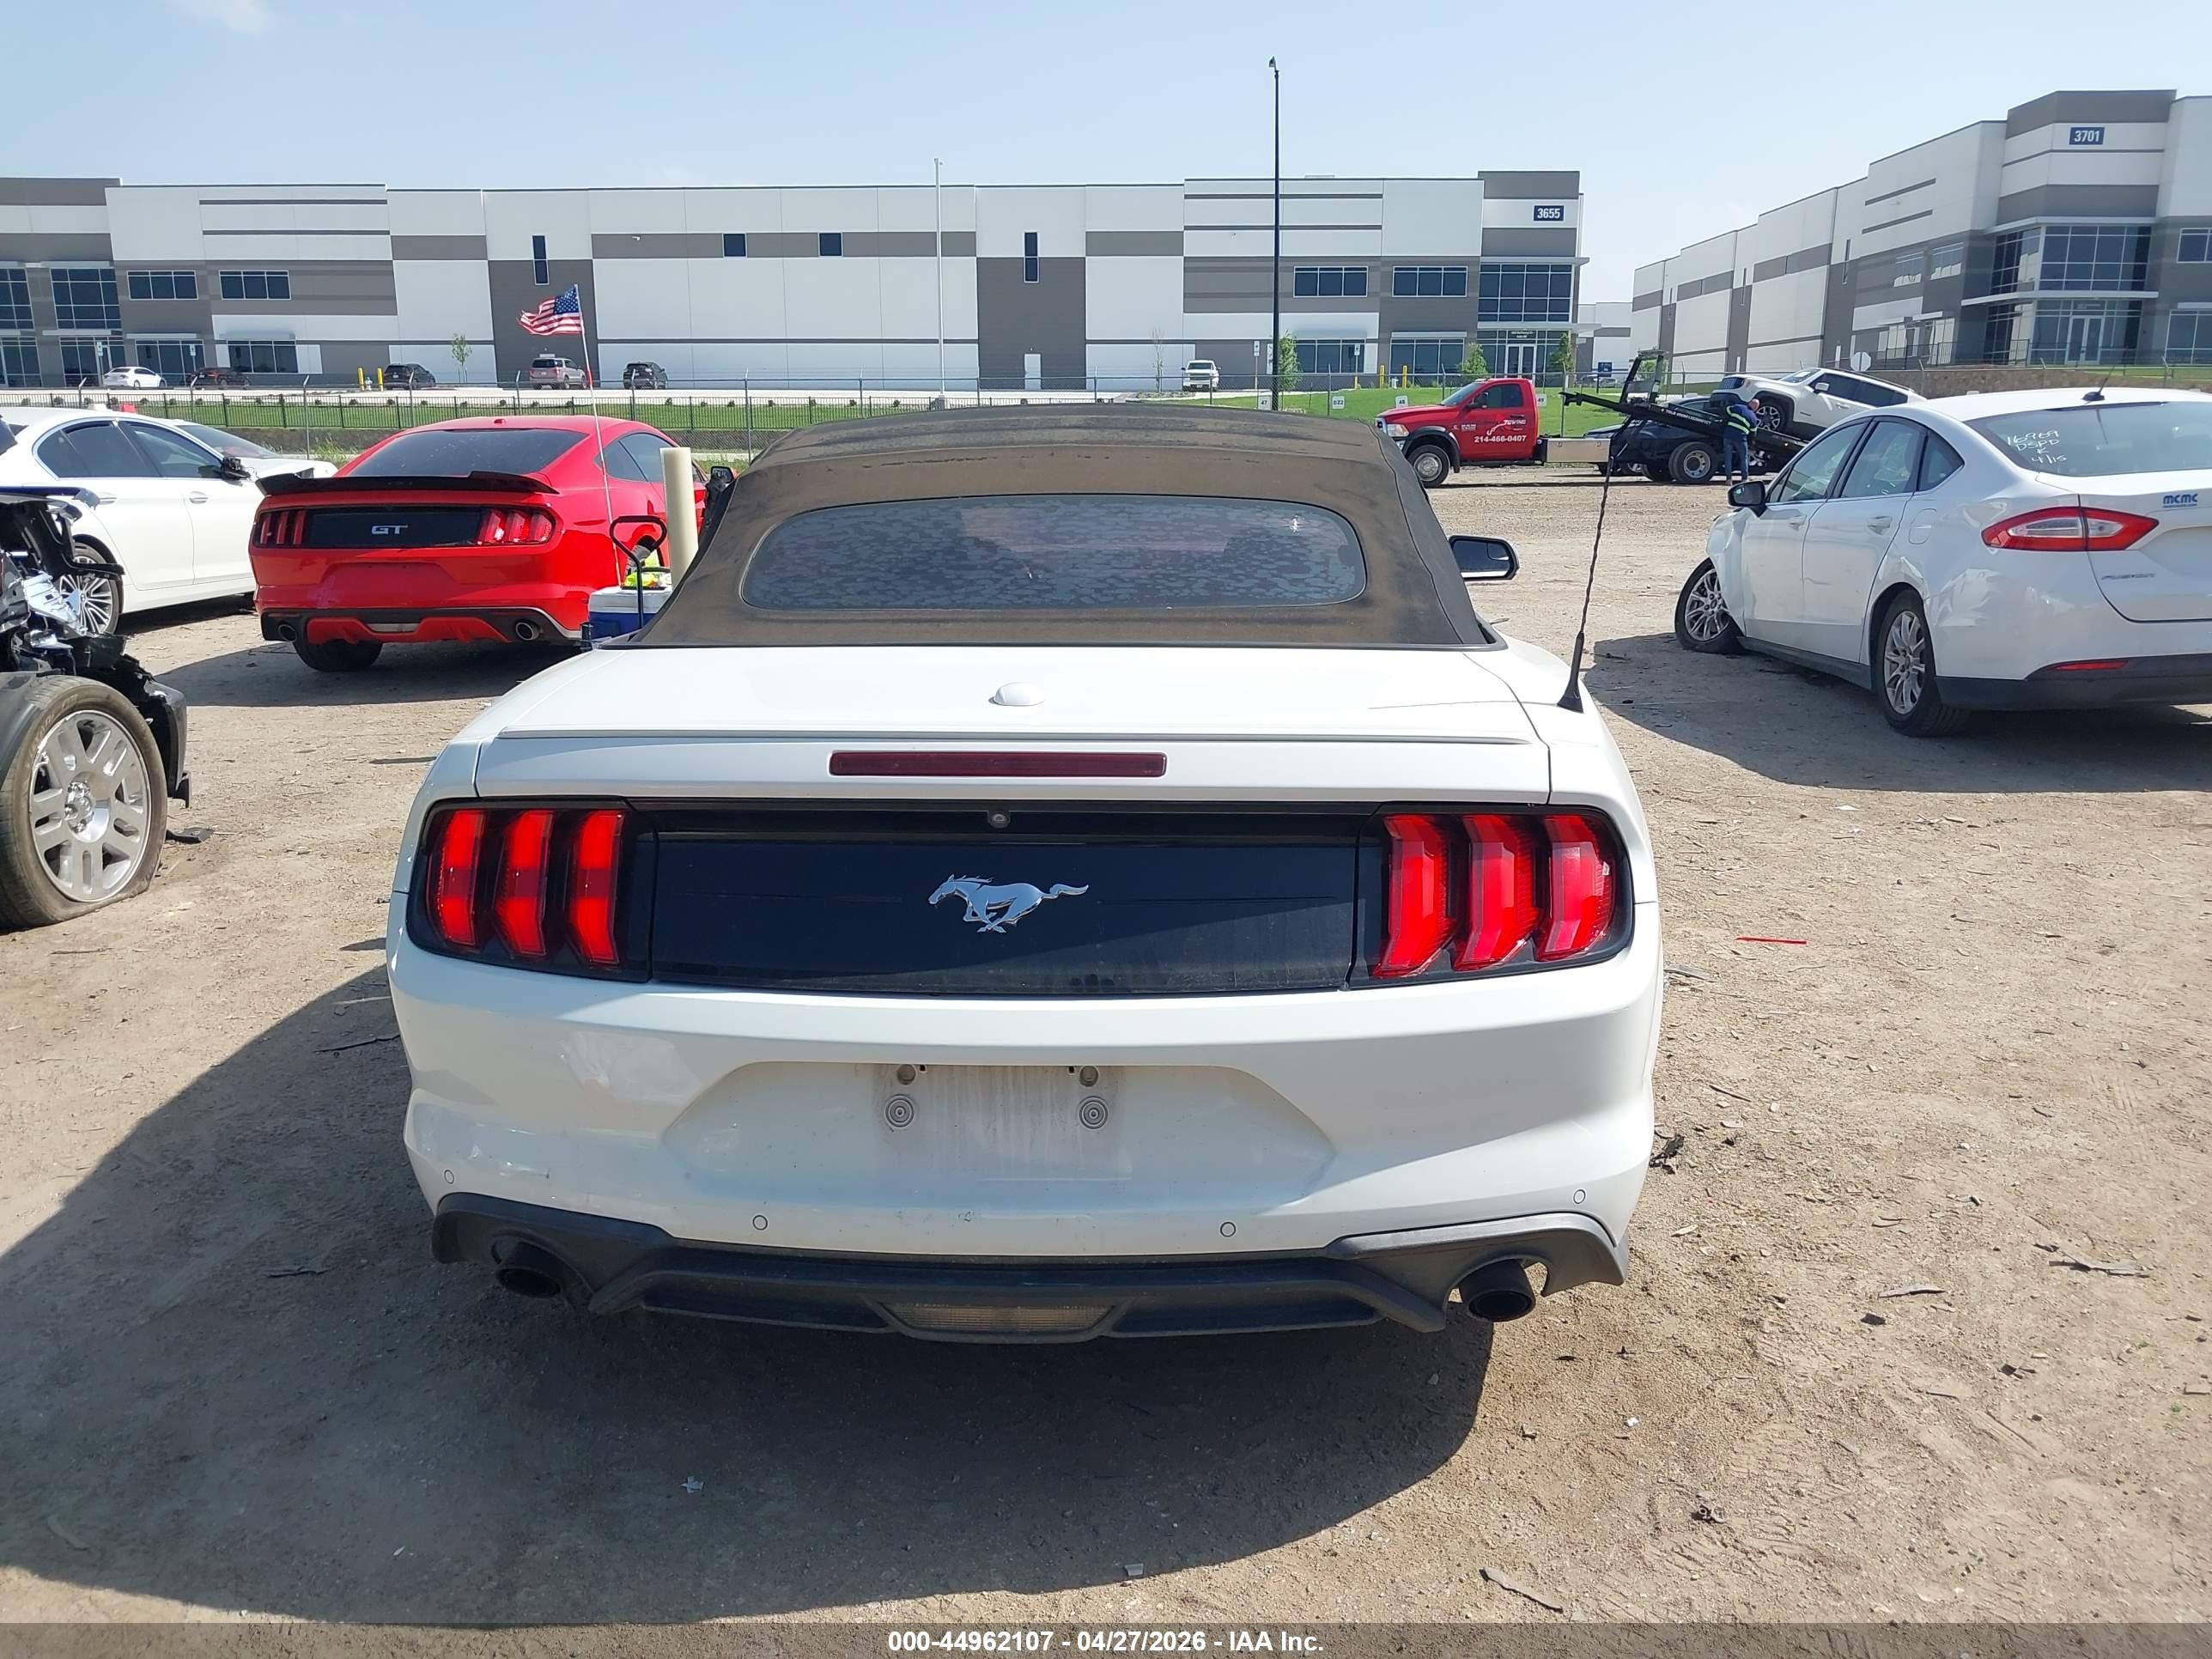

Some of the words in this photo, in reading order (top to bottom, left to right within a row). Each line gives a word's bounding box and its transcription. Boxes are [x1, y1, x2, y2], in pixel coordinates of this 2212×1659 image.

[2074, 130, 2100, 143] 3701
[1537, 208, 1560, 219] 3655
[1474, 434, 1527, 443] 214-466-0407
[371, 525, 409, 535] GT
